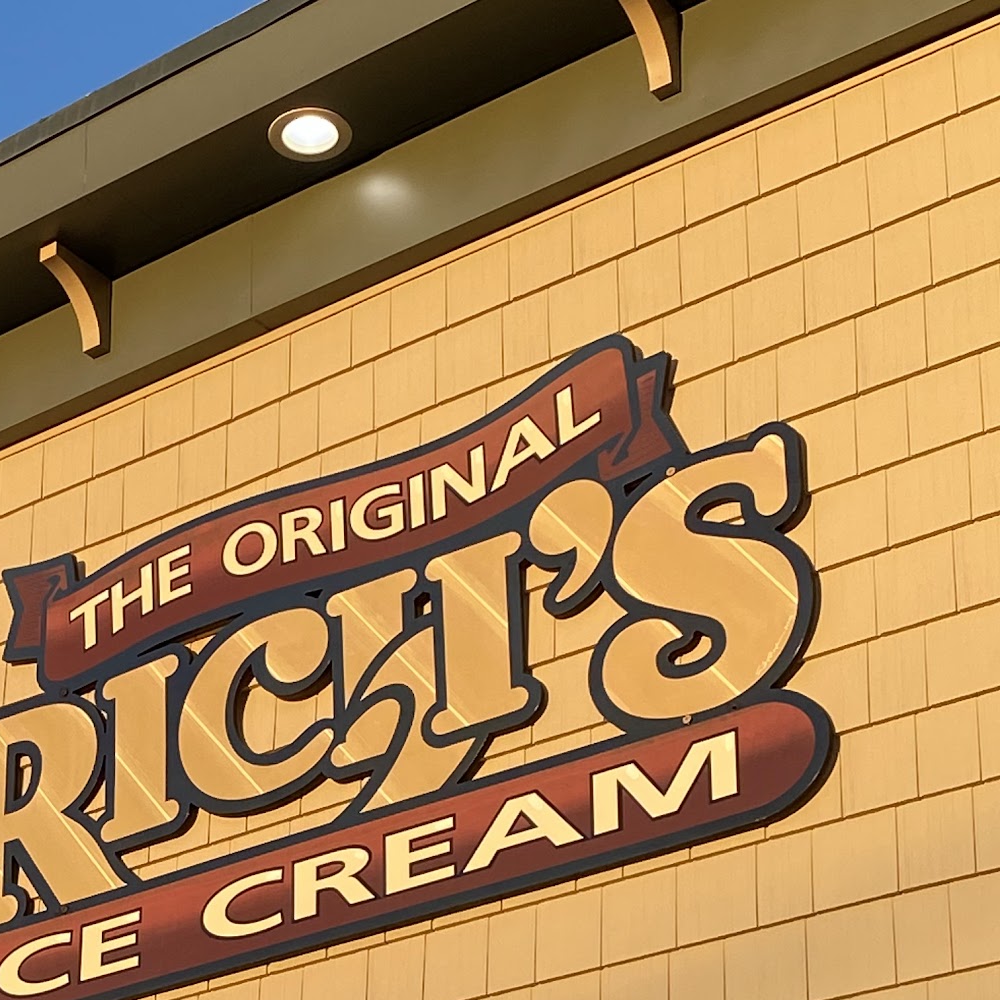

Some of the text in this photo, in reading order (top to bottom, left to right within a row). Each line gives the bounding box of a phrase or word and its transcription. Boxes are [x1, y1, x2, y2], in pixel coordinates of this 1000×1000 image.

[70, 386, 602, 651] THE ORIGINAL
[202, 730, 741, 938] CREAM
